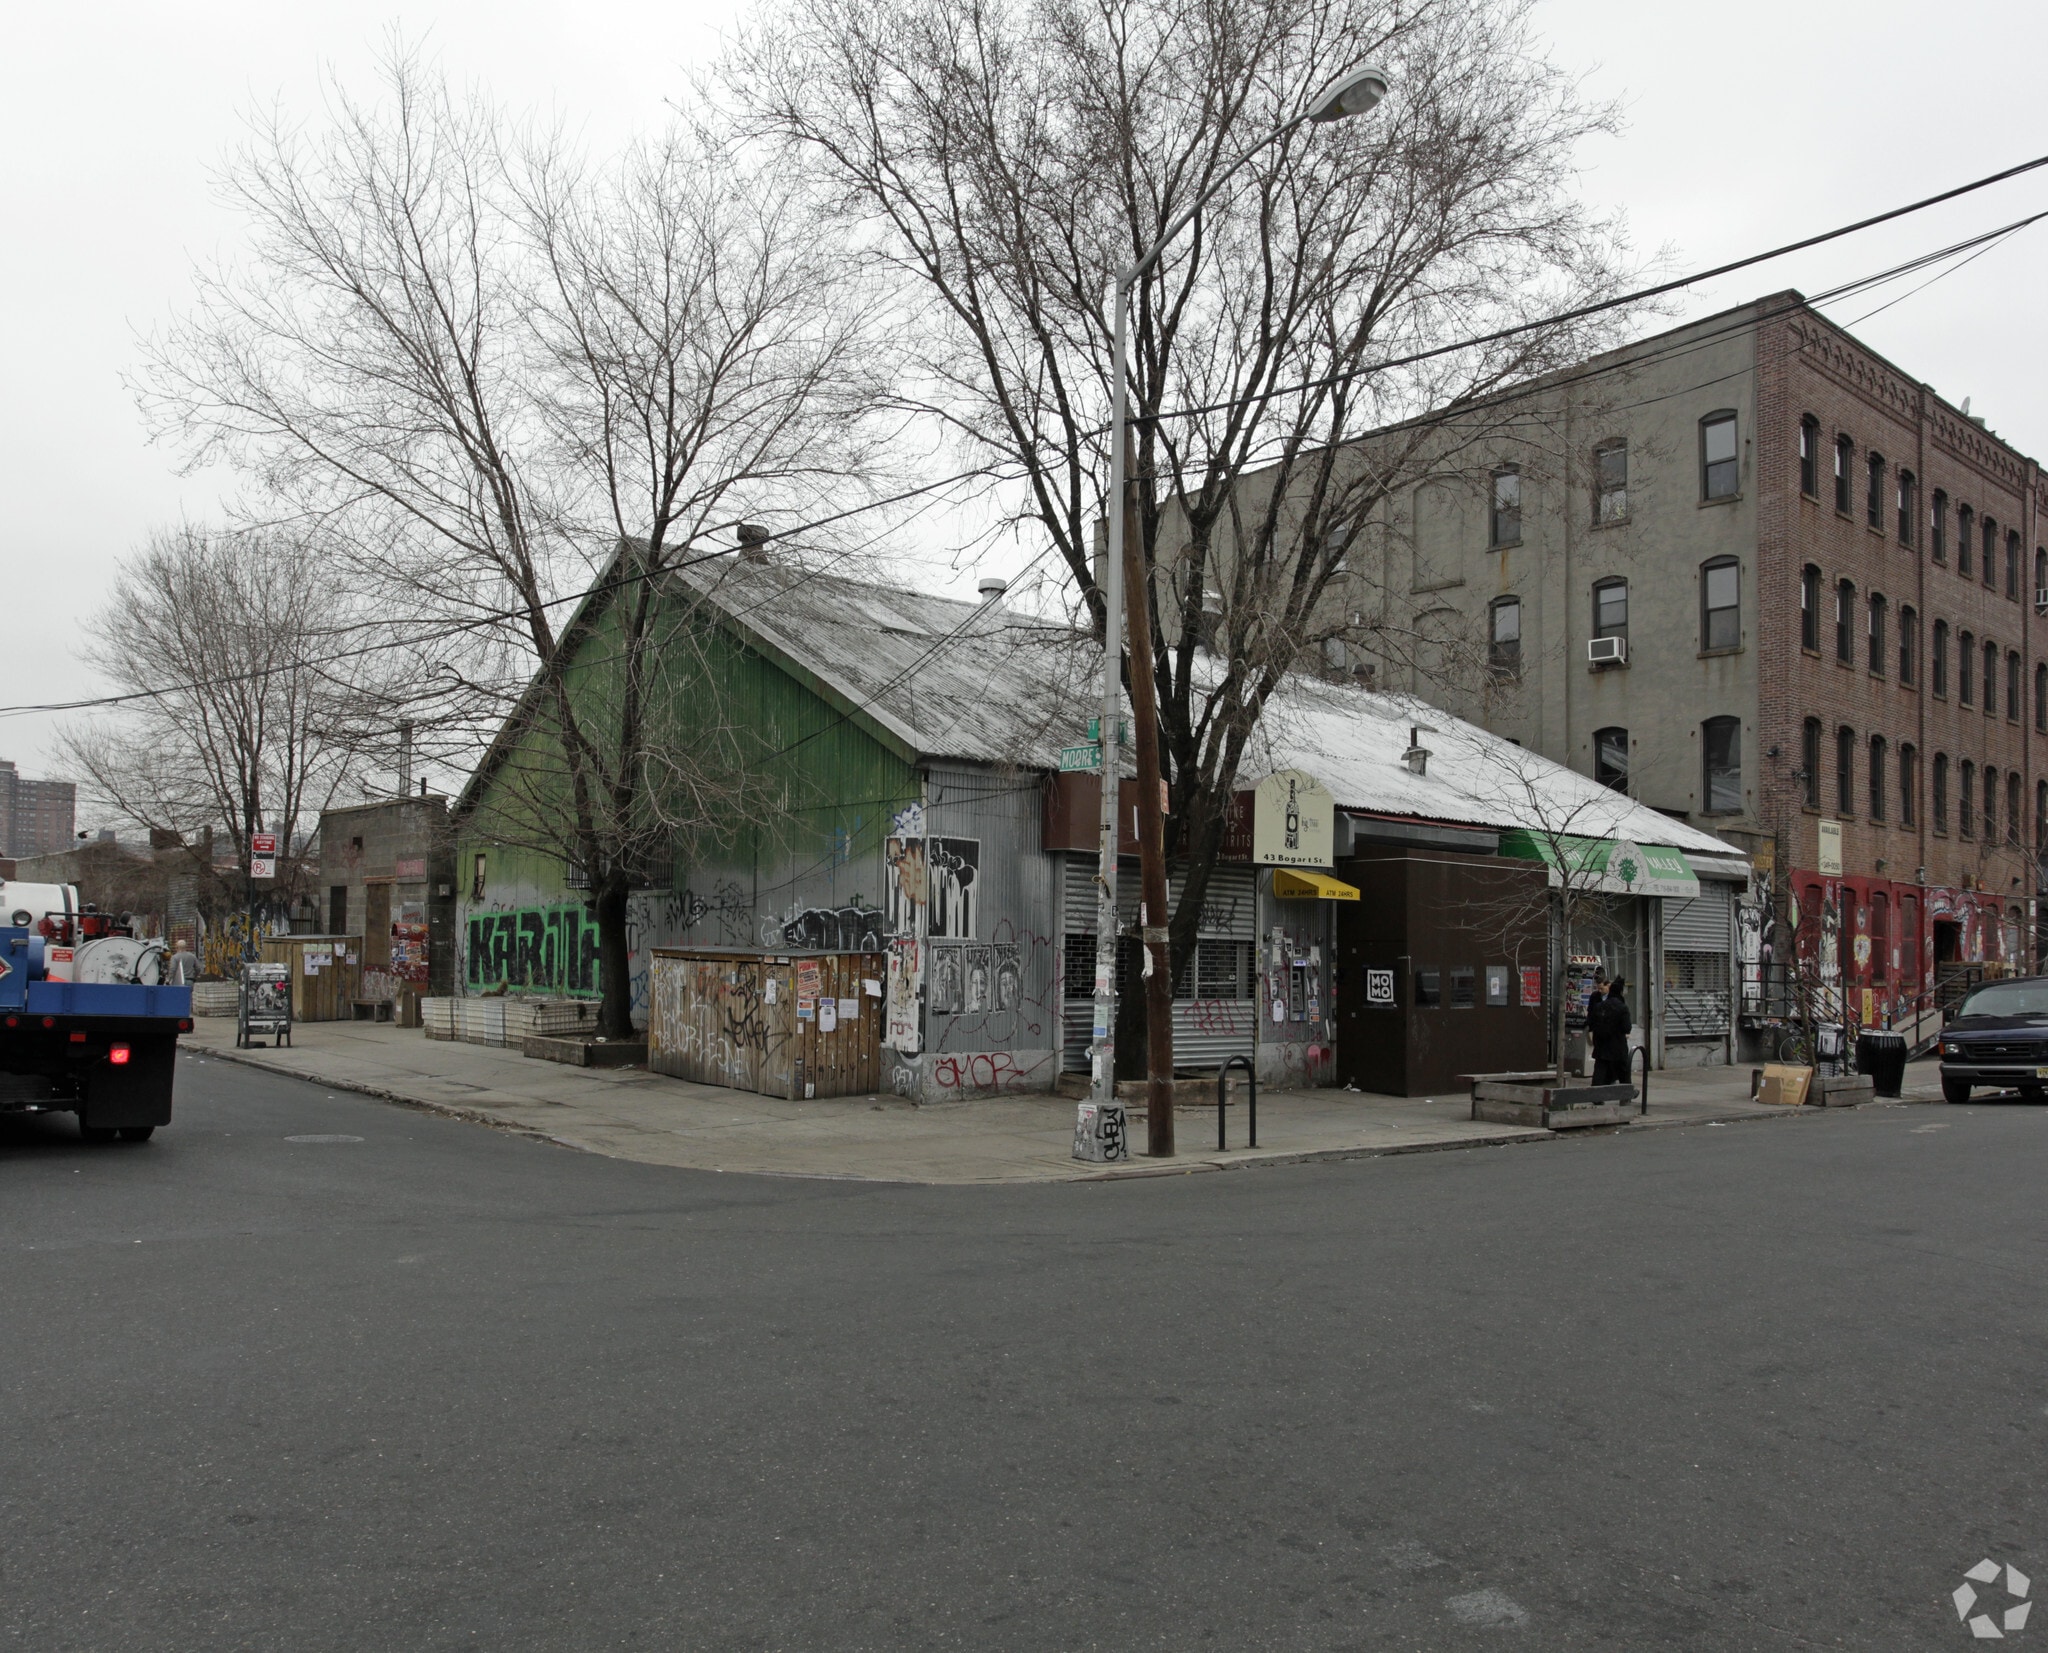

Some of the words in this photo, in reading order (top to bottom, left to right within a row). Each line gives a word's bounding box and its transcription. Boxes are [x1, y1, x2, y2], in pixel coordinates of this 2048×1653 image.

[1062, 748, 1094, 768] MOORE
[1278, 854, 1312, 864] Bogart
[1570, 955, 1597, 963] ATM
[1371, 975, 1389, 986] MO
[1371, 987, 1391, 998] MO
